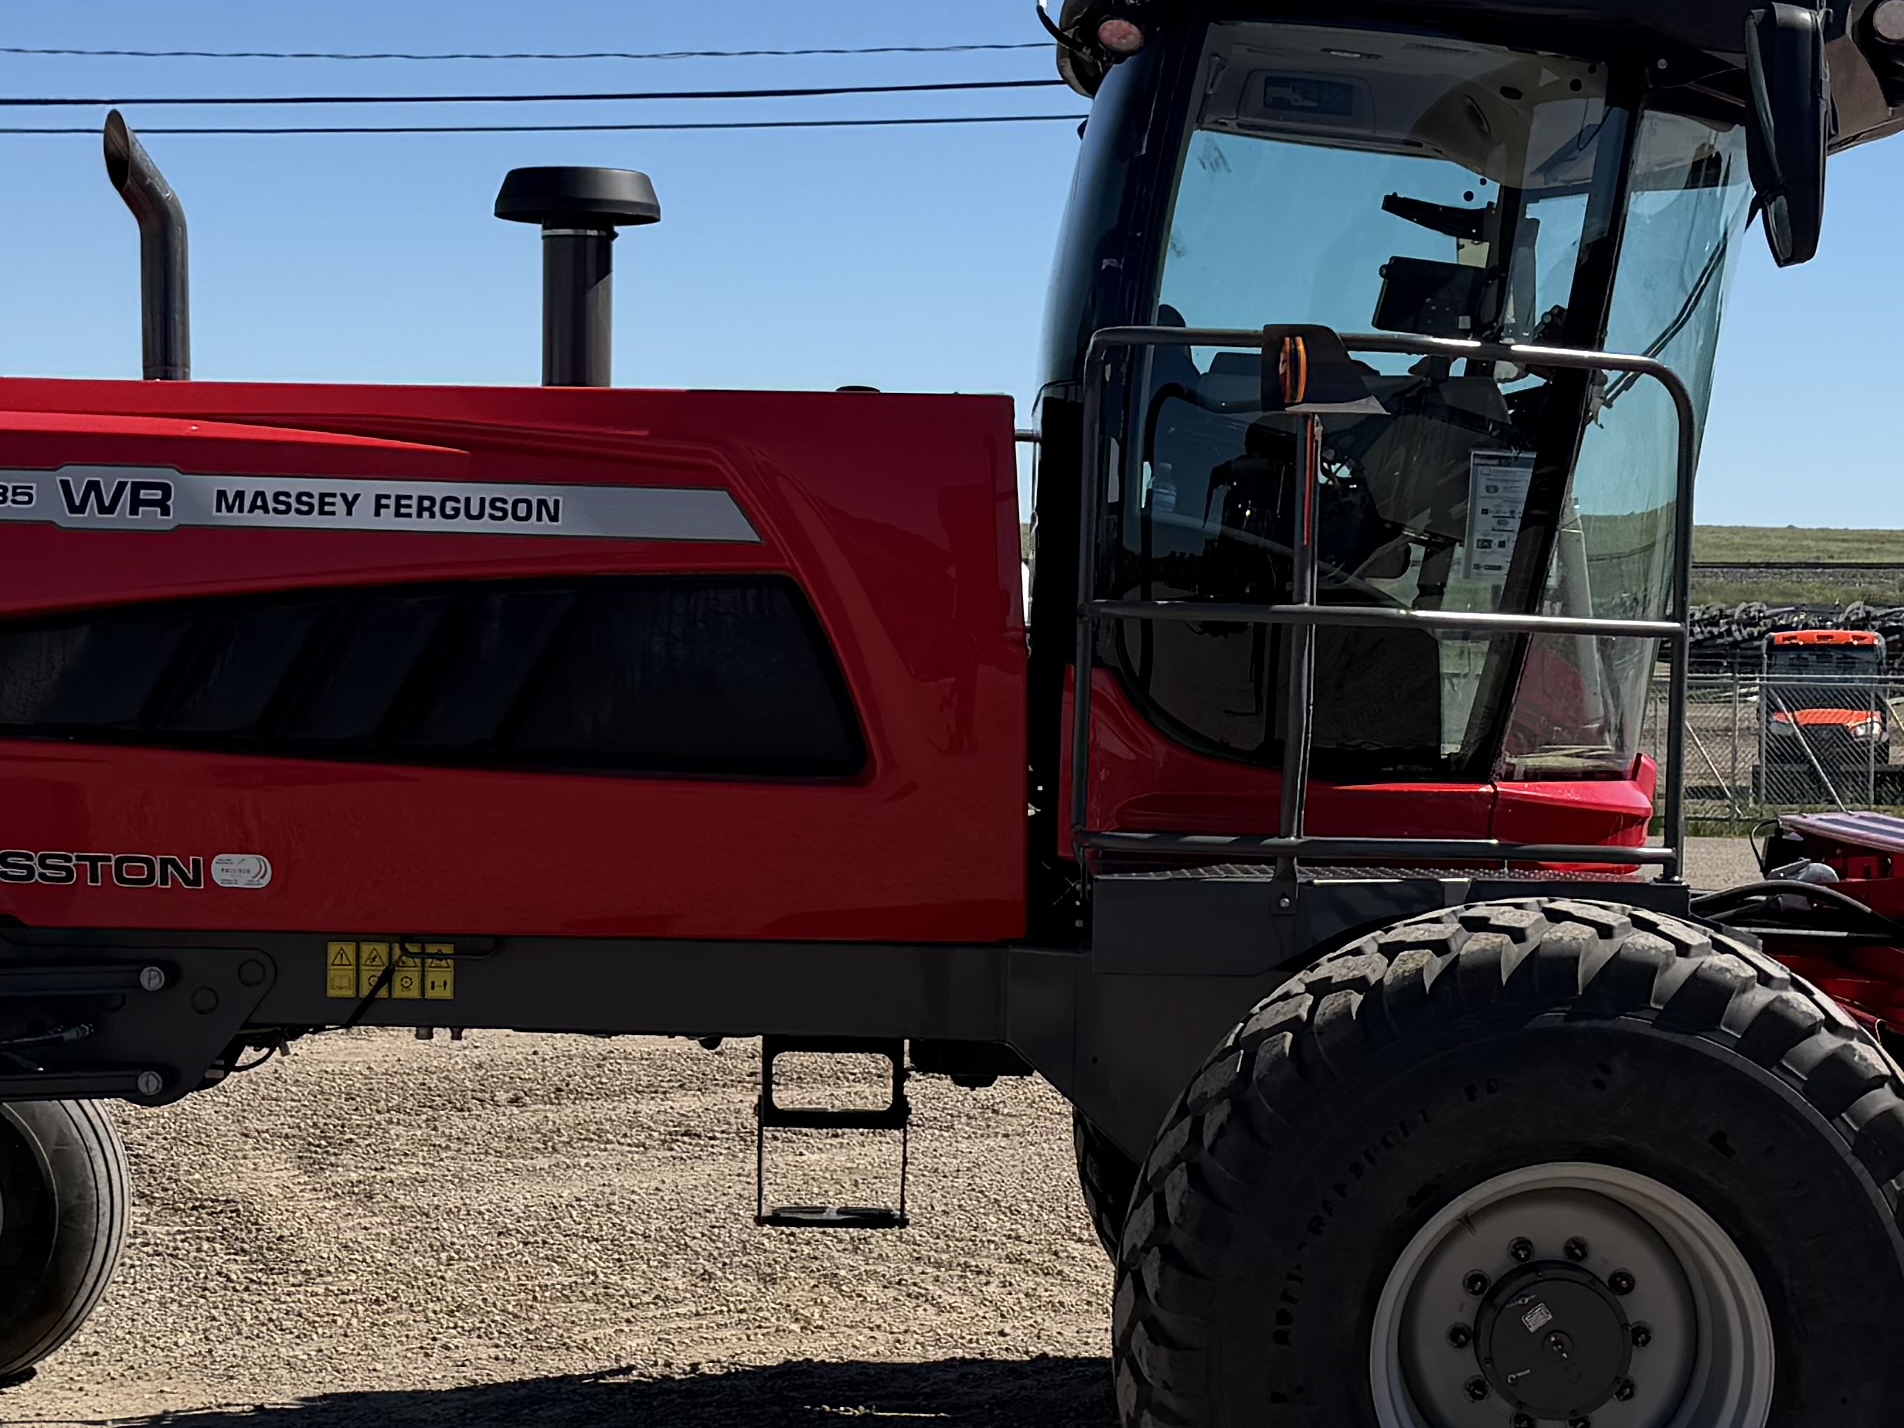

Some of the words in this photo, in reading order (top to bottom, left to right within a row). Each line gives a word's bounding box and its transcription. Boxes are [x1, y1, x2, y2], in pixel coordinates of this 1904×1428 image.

[59, 477, 174, 518] WR
[214, 488, 361, 517] MASSEY
[373, 492, 561, 524] FERGUSON
